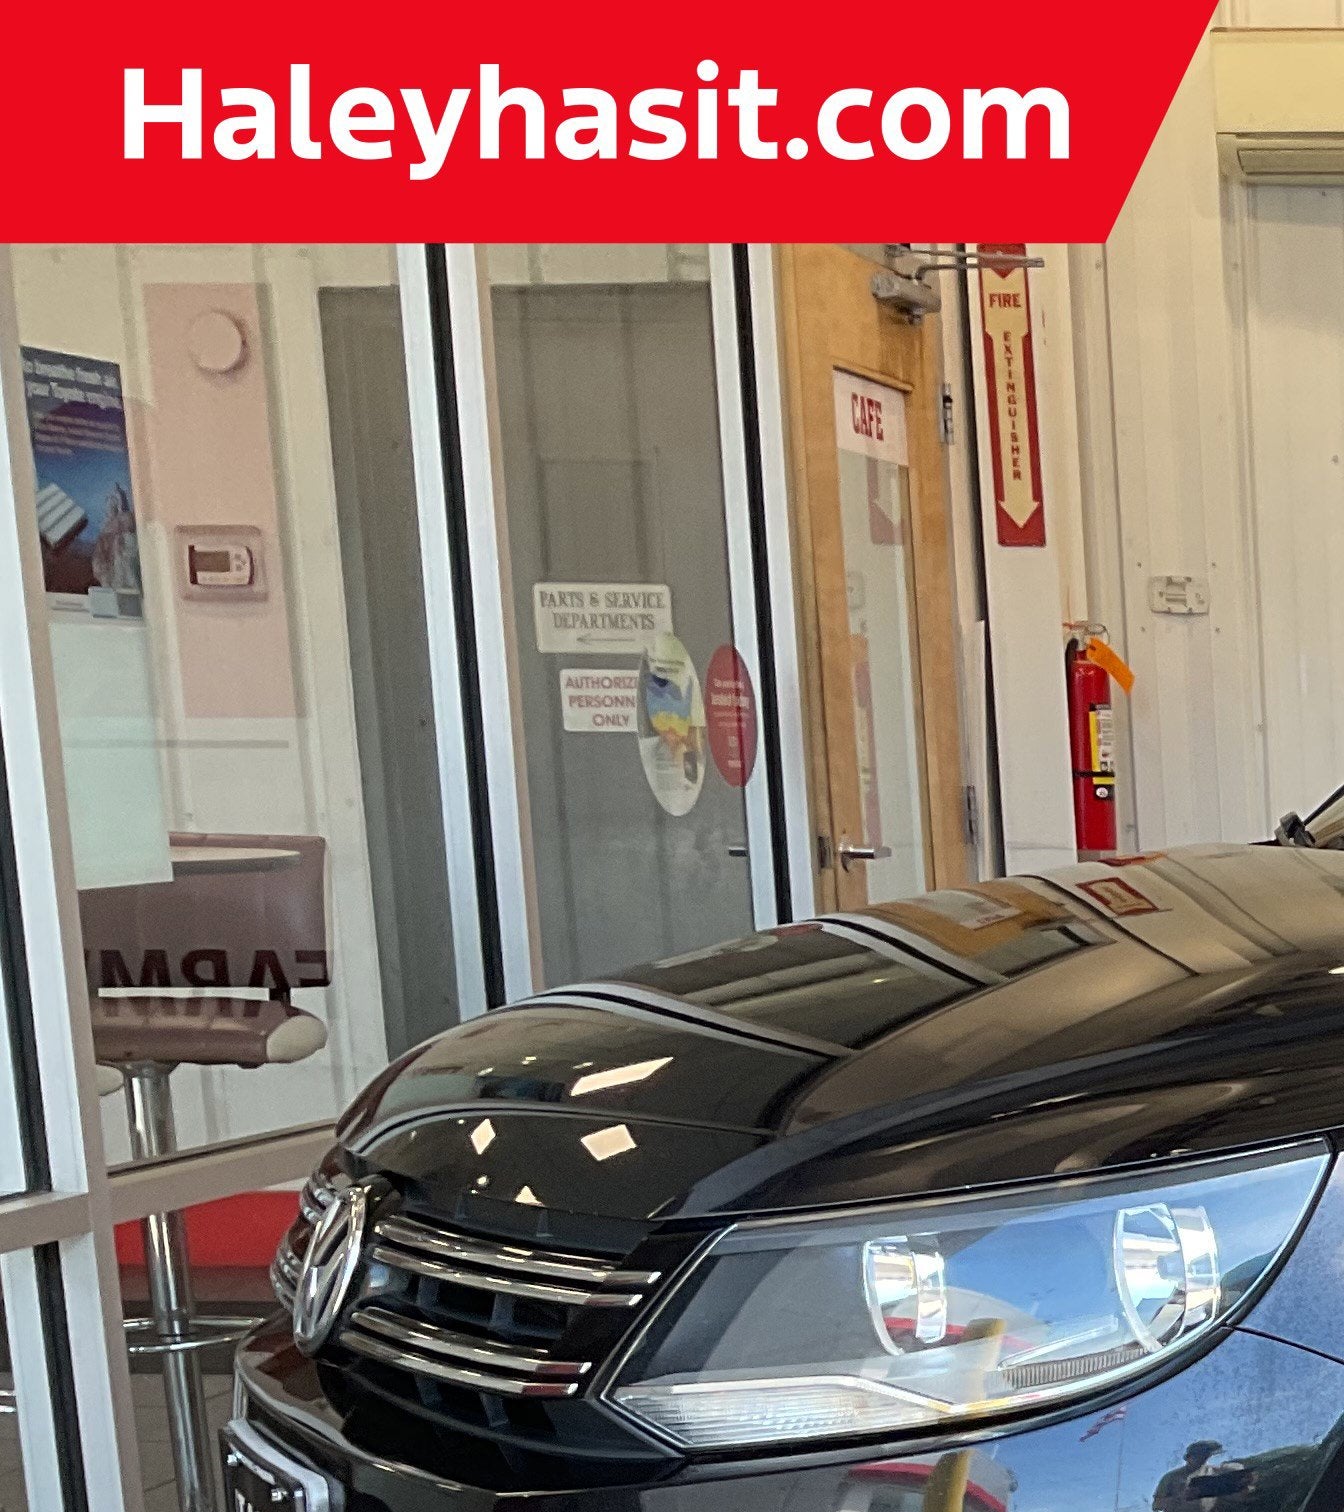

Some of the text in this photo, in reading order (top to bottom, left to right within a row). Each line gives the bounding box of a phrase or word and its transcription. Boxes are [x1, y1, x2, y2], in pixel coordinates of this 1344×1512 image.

[989, 292, 1022, 308] FIRE
[1002, 330, 1022, 481] EXTINGUISHER
[851, 391, 884, 441] CAFE
[540, 590, 585, 609] PARTS
[604, 590, 666, 609] SERVICE
[552, 611, 656, 632] DEPARTMENTS
[565, 676, 638, 690] AUTHORIZ
[568, 694, 636, 708] PERSONN
[592, 713, 630, 727] ONLY
